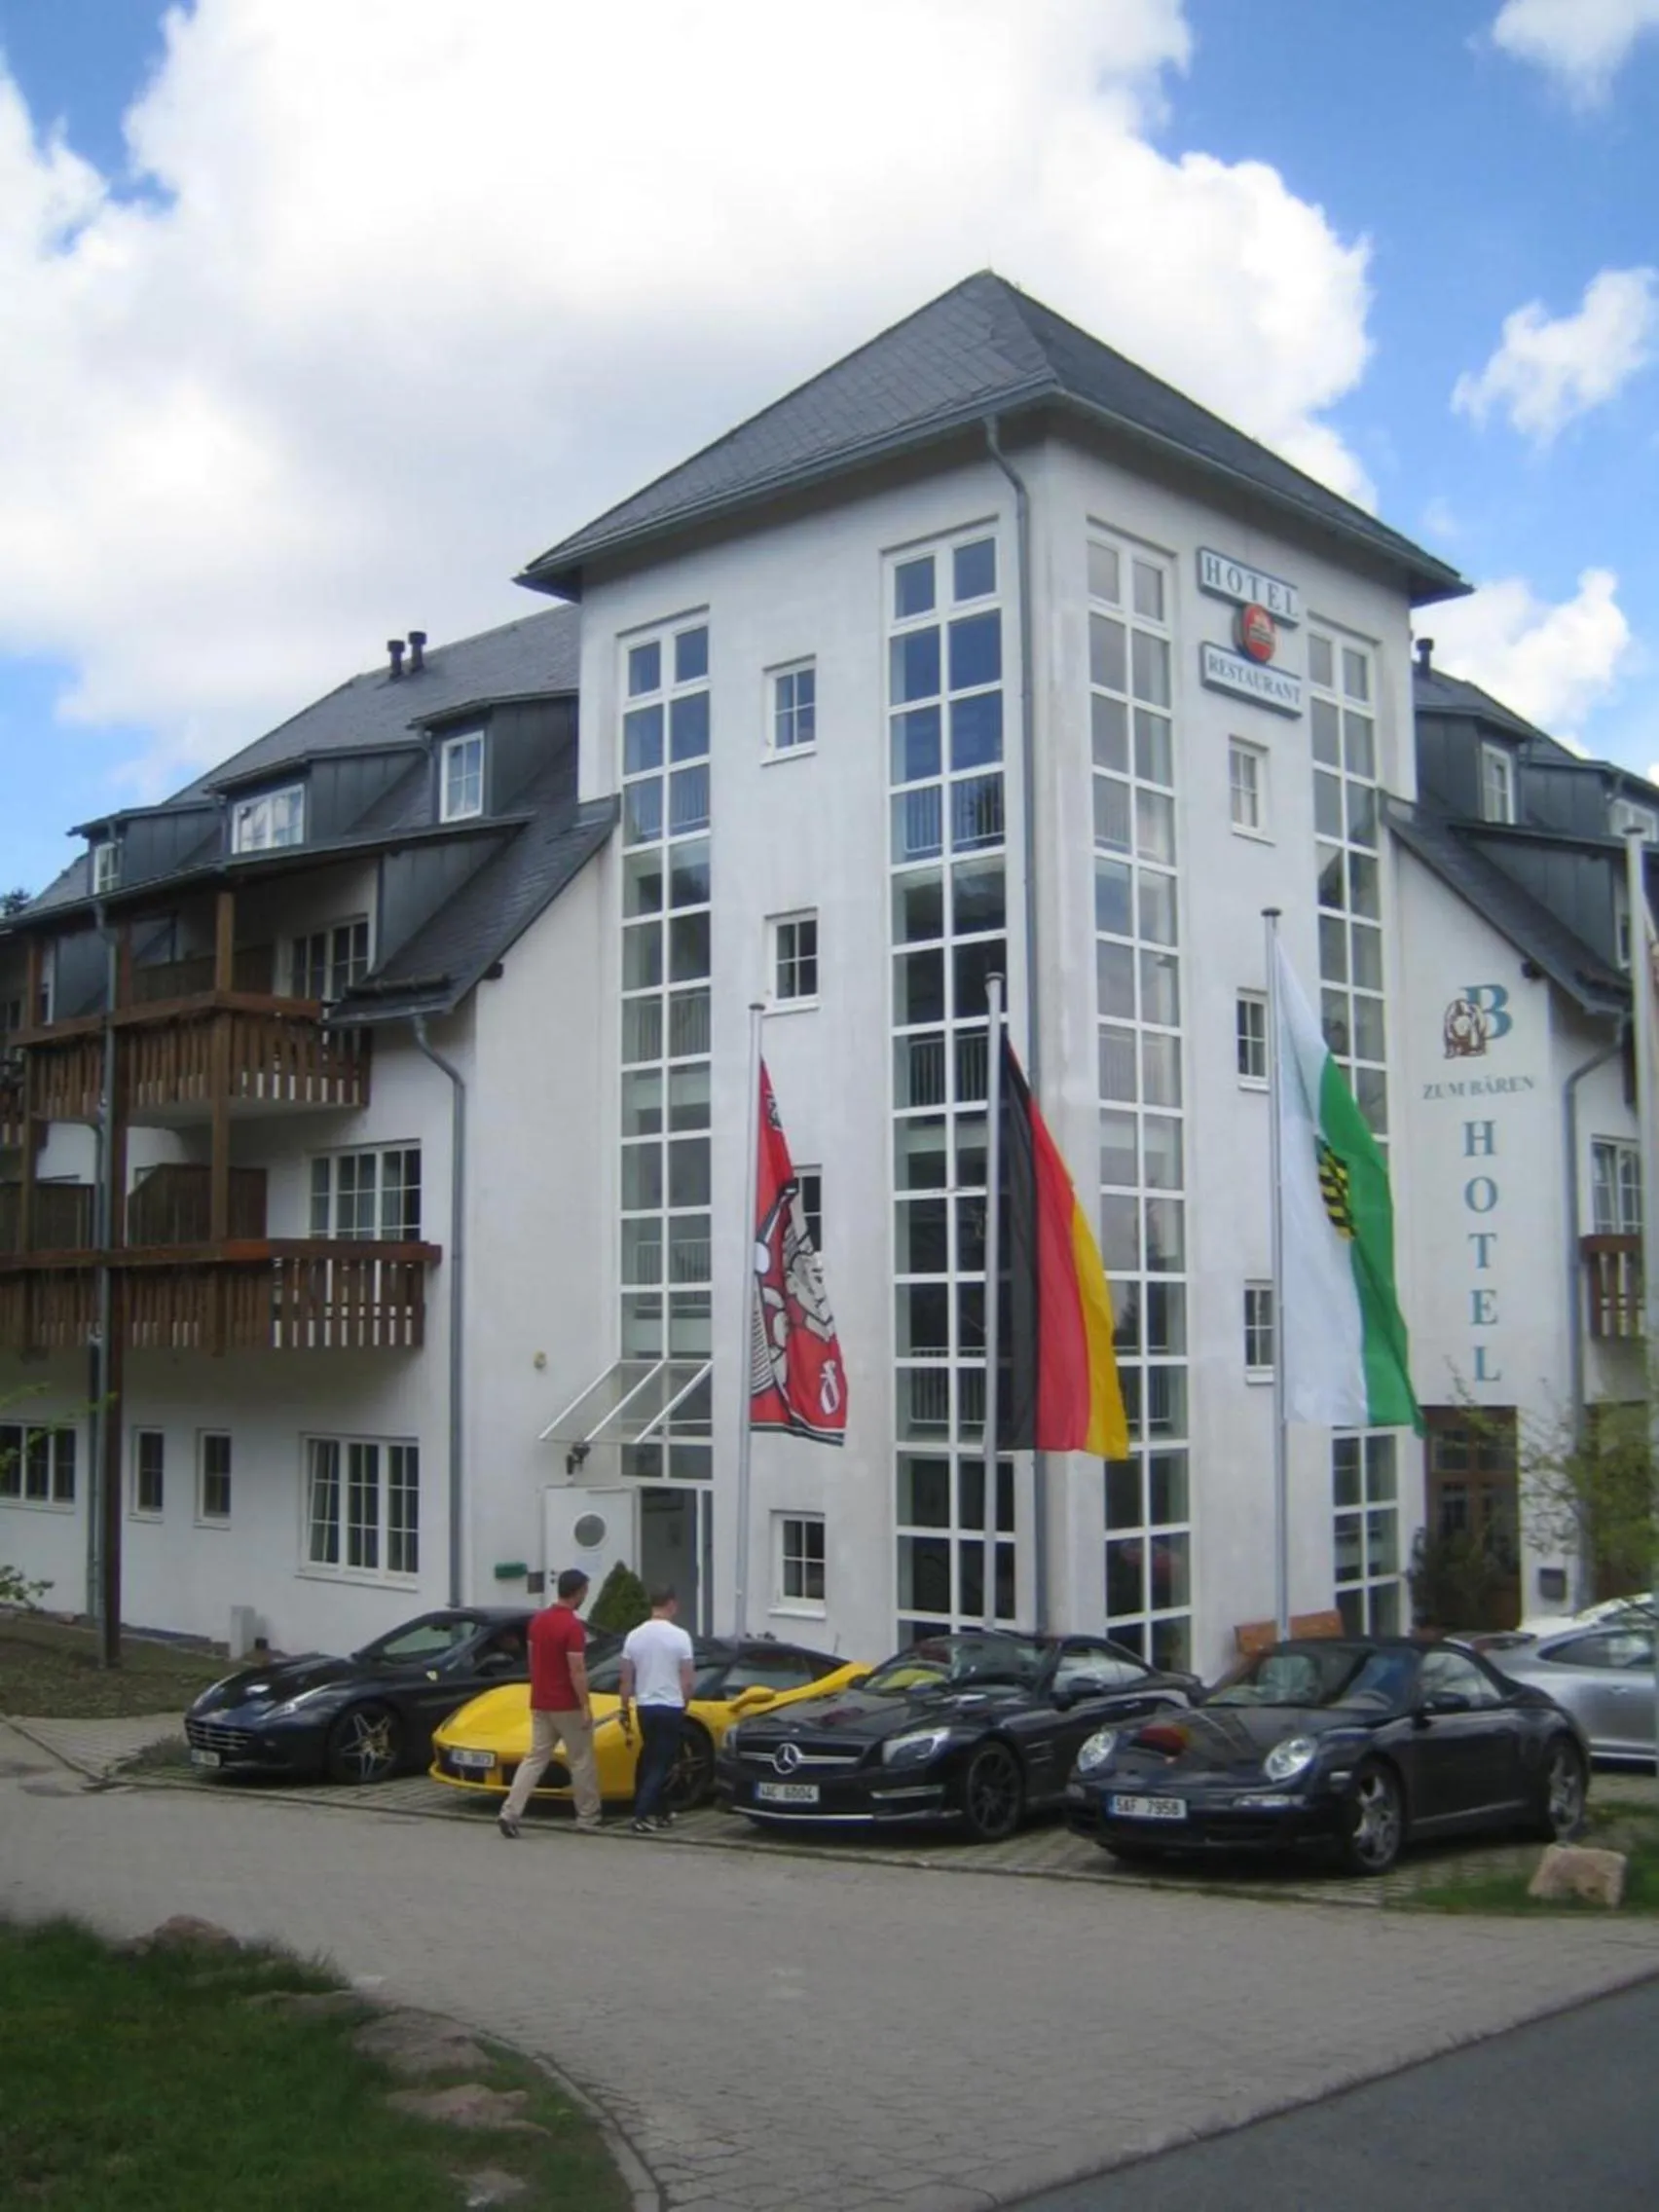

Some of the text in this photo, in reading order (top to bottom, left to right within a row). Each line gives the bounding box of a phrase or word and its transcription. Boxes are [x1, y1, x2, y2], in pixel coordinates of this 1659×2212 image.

[1206, 556, 1300, 617] HOTEL
[1207, 653, 1301, 705] RESTAURANT
[1421, 1074, 1535, 1100] ZUM BÄREN
[1463, 1120, 1502, 1383] HOTEL
